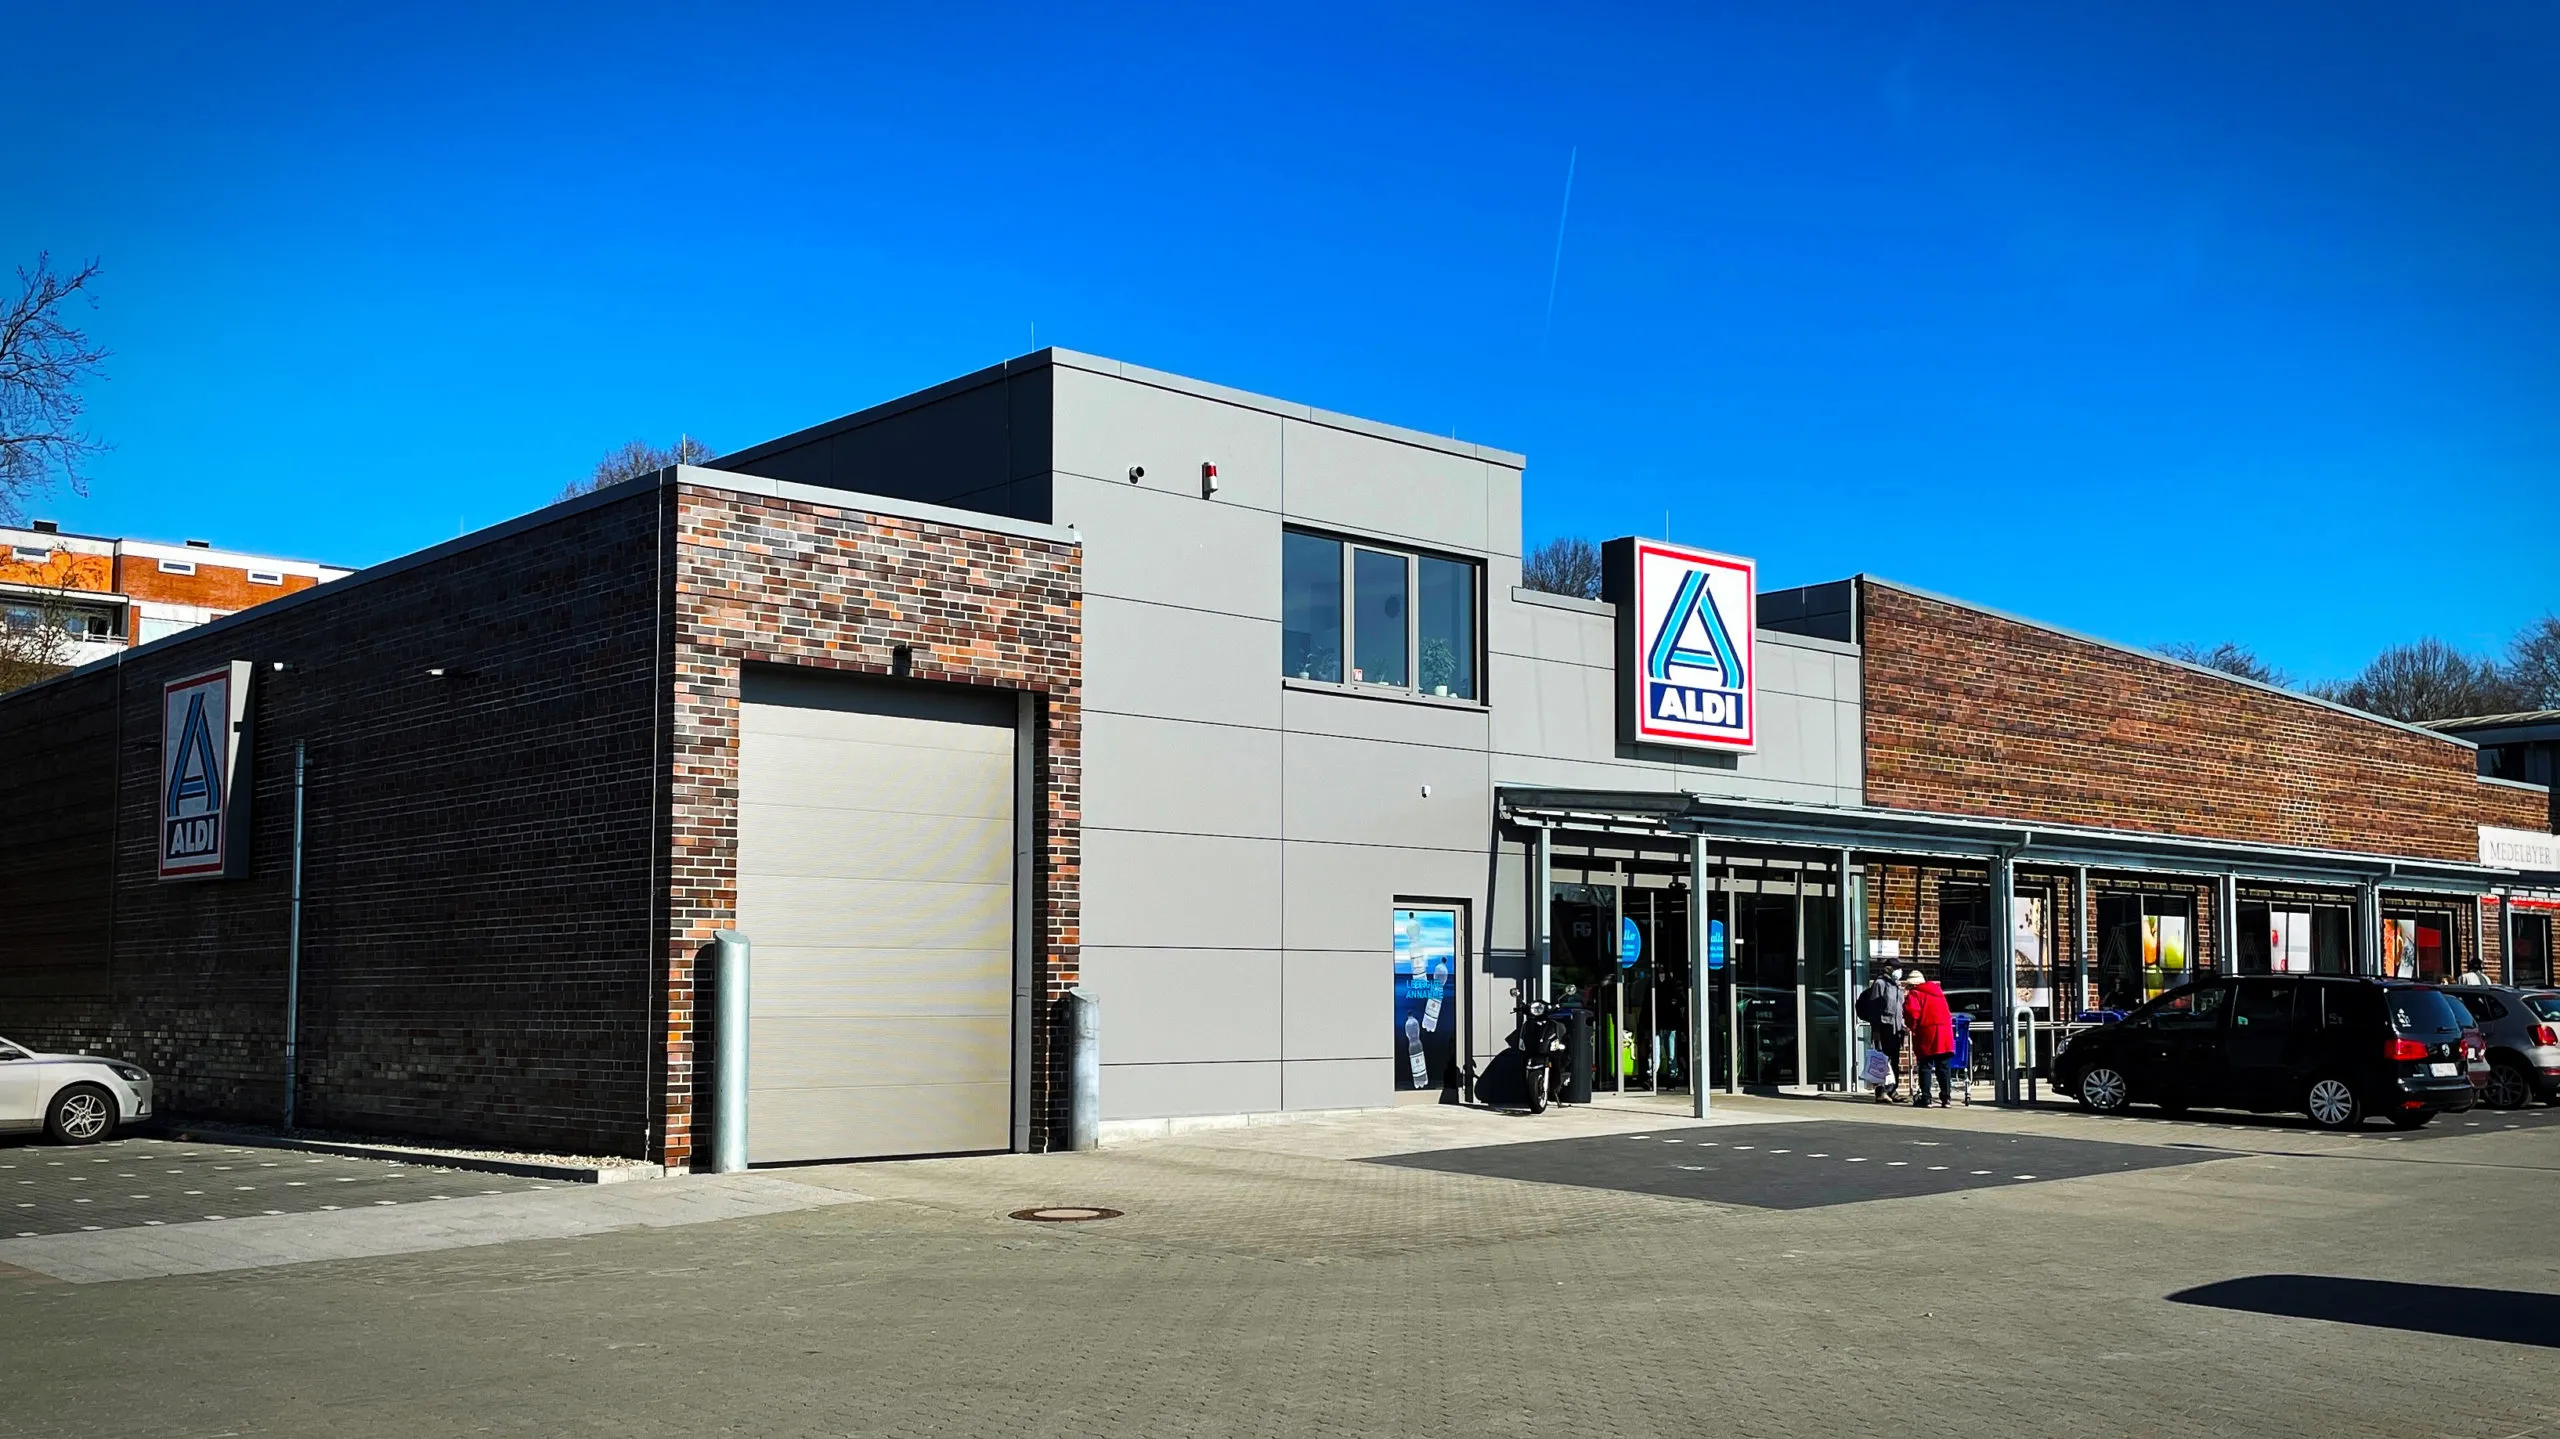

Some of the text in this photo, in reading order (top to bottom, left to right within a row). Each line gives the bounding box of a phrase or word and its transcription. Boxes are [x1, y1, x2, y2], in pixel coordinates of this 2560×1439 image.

[1657, 687, 1737, 726] ALDI
[170, 818, 215, 855] ALDI
[2490, 840, 2552, 865] MEDELBYER
